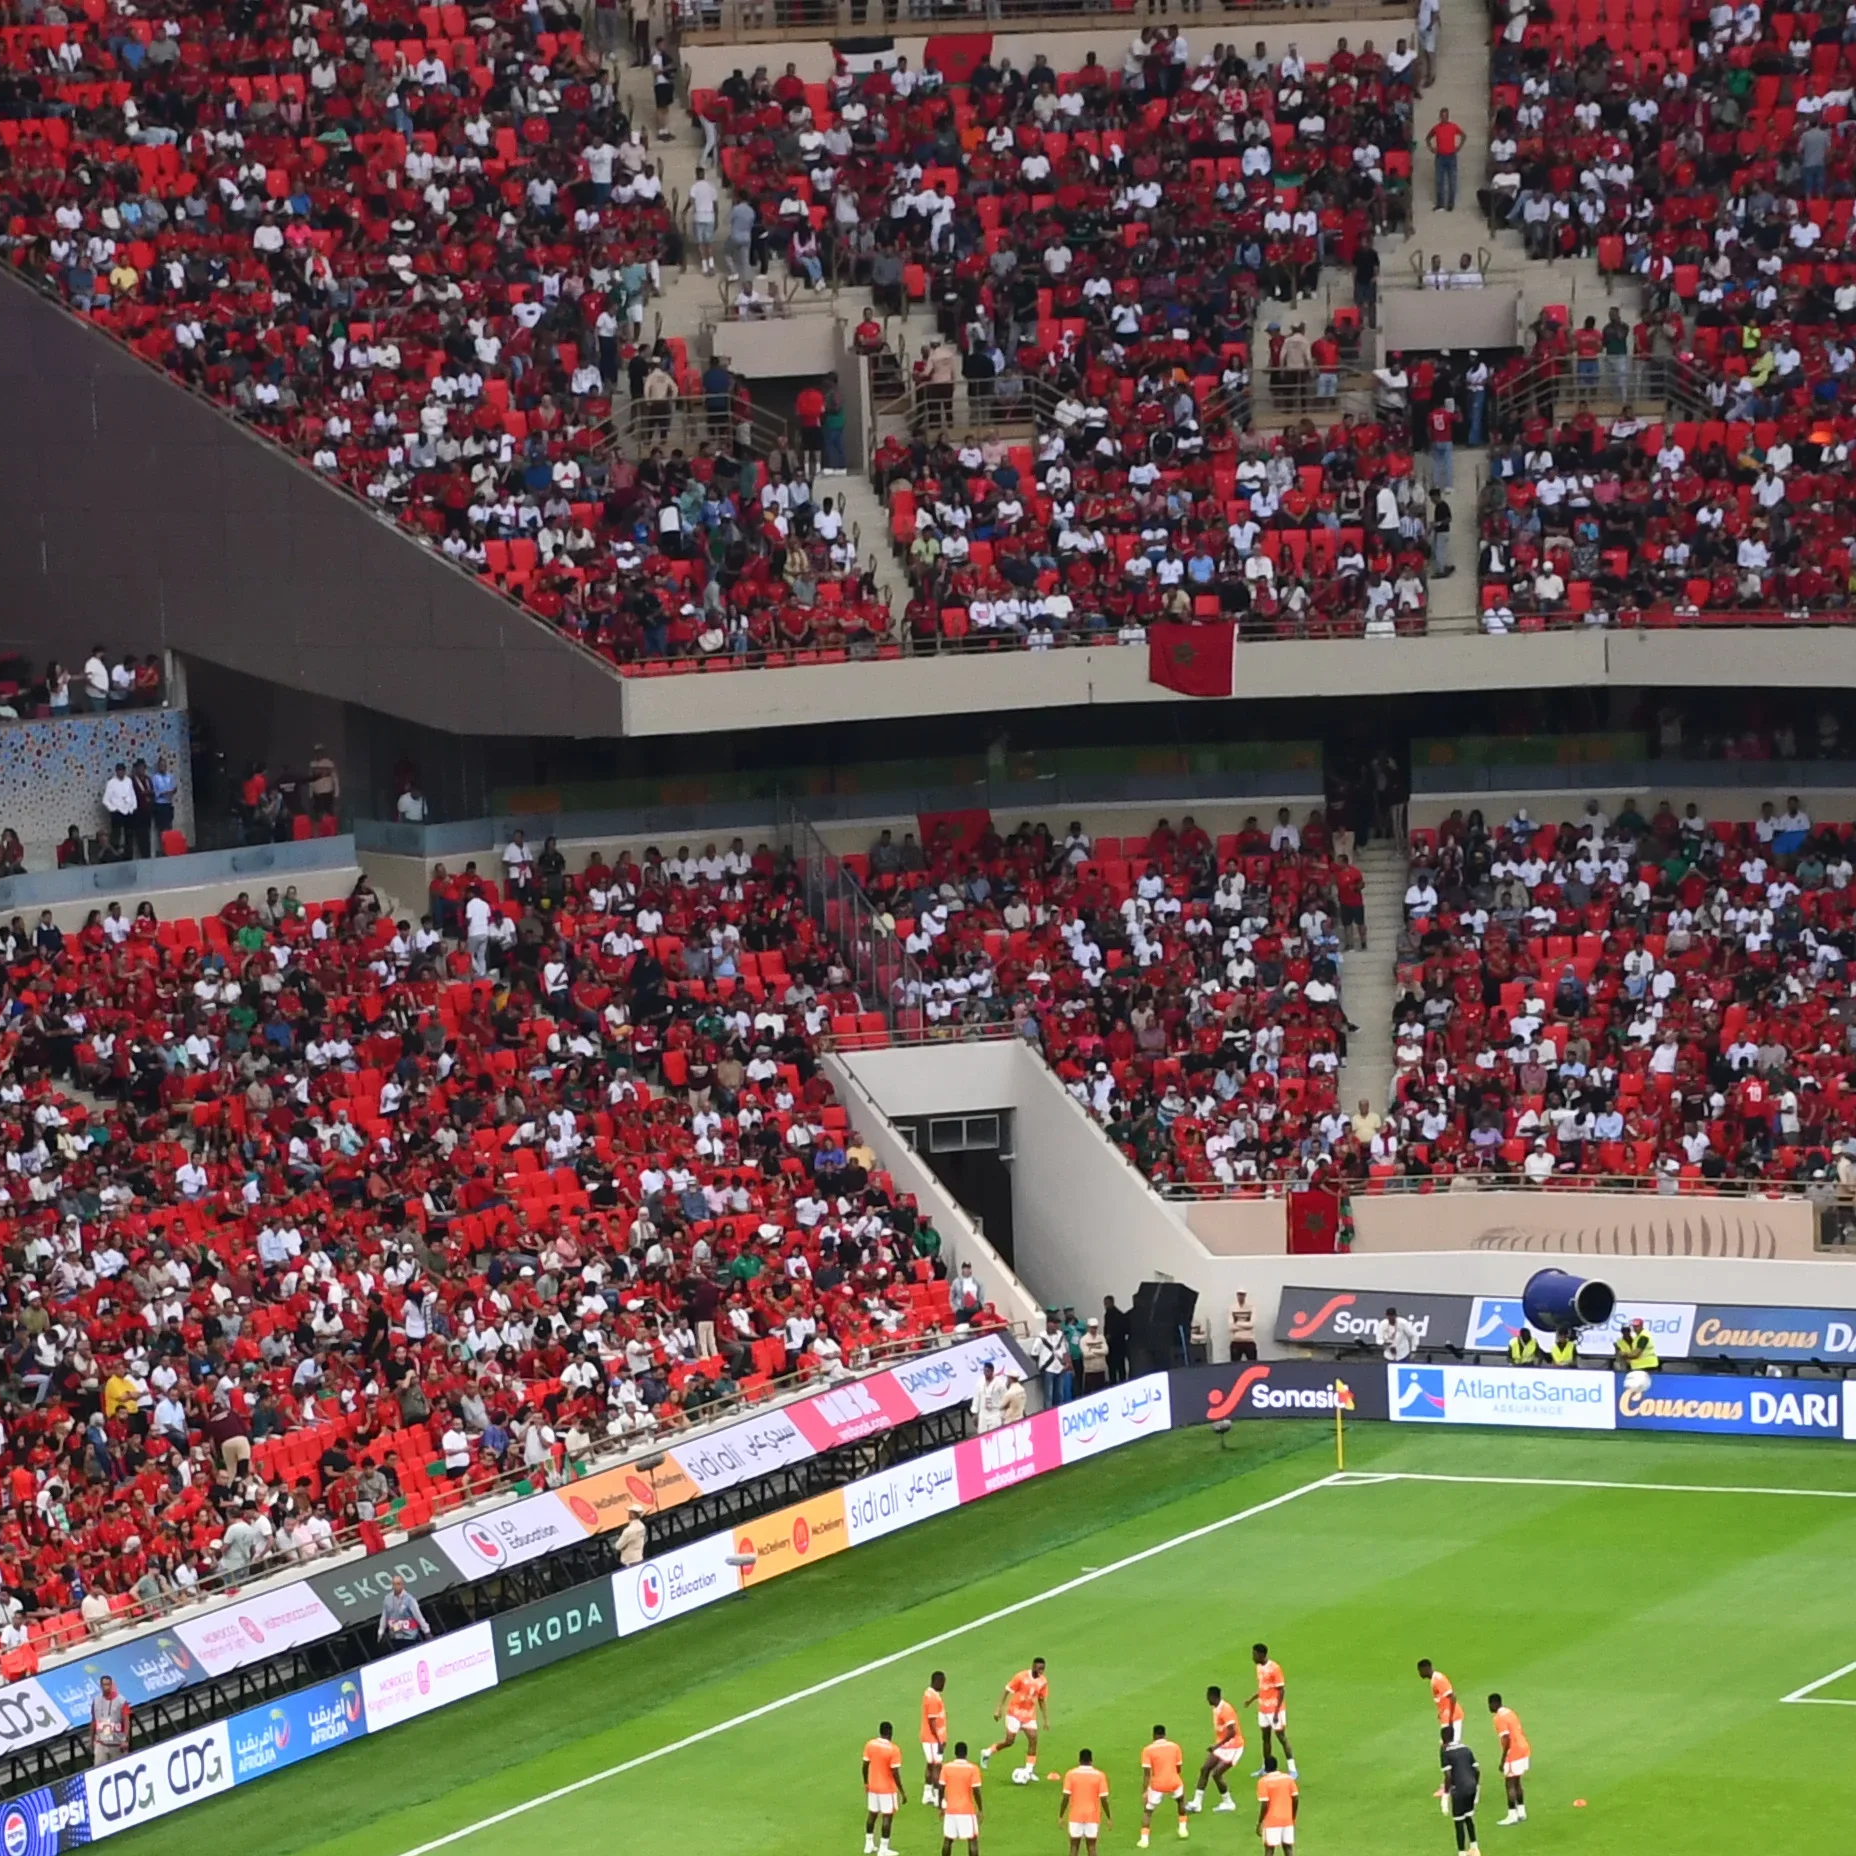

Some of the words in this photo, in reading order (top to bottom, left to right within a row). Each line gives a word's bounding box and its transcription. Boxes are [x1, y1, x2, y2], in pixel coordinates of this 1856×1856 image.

[1333, 1311, 1430, 1337] Sonid
[1695, 1318, 1819, 1348] Couscous
[1454, 1378, 1602, 1403] AtlantaSanad
[1619, 1389, 1743, 1419] Couscous
[1750, 1391, 1838, 1426] DARI
[667, 1562, 684, 1583] LCI
[167, 1738, 224, 1795] CDG
[98, 1763, 156, 1822] CDG
[38, 1799, 88, 1835] PEPSI
